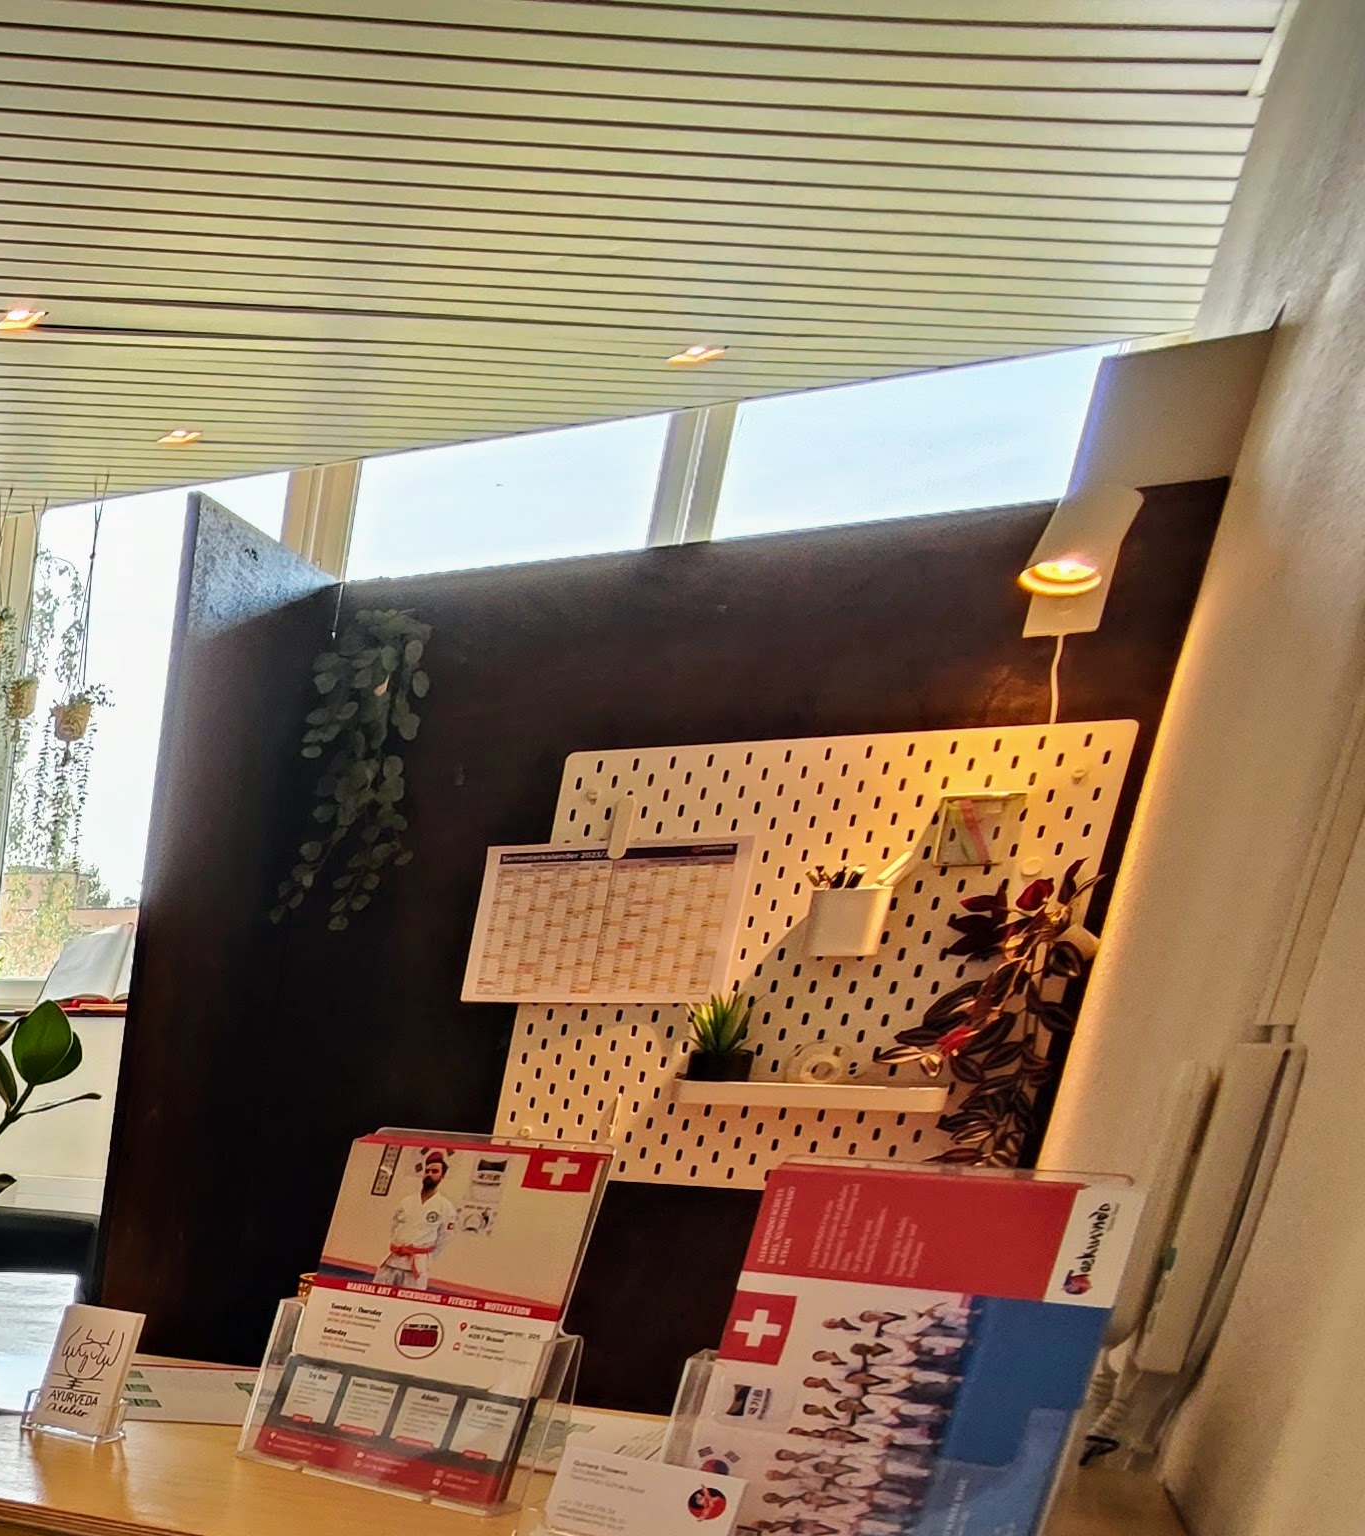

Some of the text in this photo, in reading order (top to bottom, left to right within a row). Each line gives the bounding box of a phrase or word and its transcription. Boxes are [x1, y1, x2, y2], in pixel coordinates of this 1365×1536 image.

[346, 1281, 376, 1294] MARTIAL
[376, 1286, 392, 1296] ART
[447, 1296, 478, 1308] FITNESS
[483, 1302, 531, 1316] MOTIVATION
[331, 1302, 353, 1313] Tuesday
[357, 1306, 383, 1317] Thursday
[323, 1326, 347, 1337] Saturday
[48, 1389, 98, 1406] AYURVEDA
